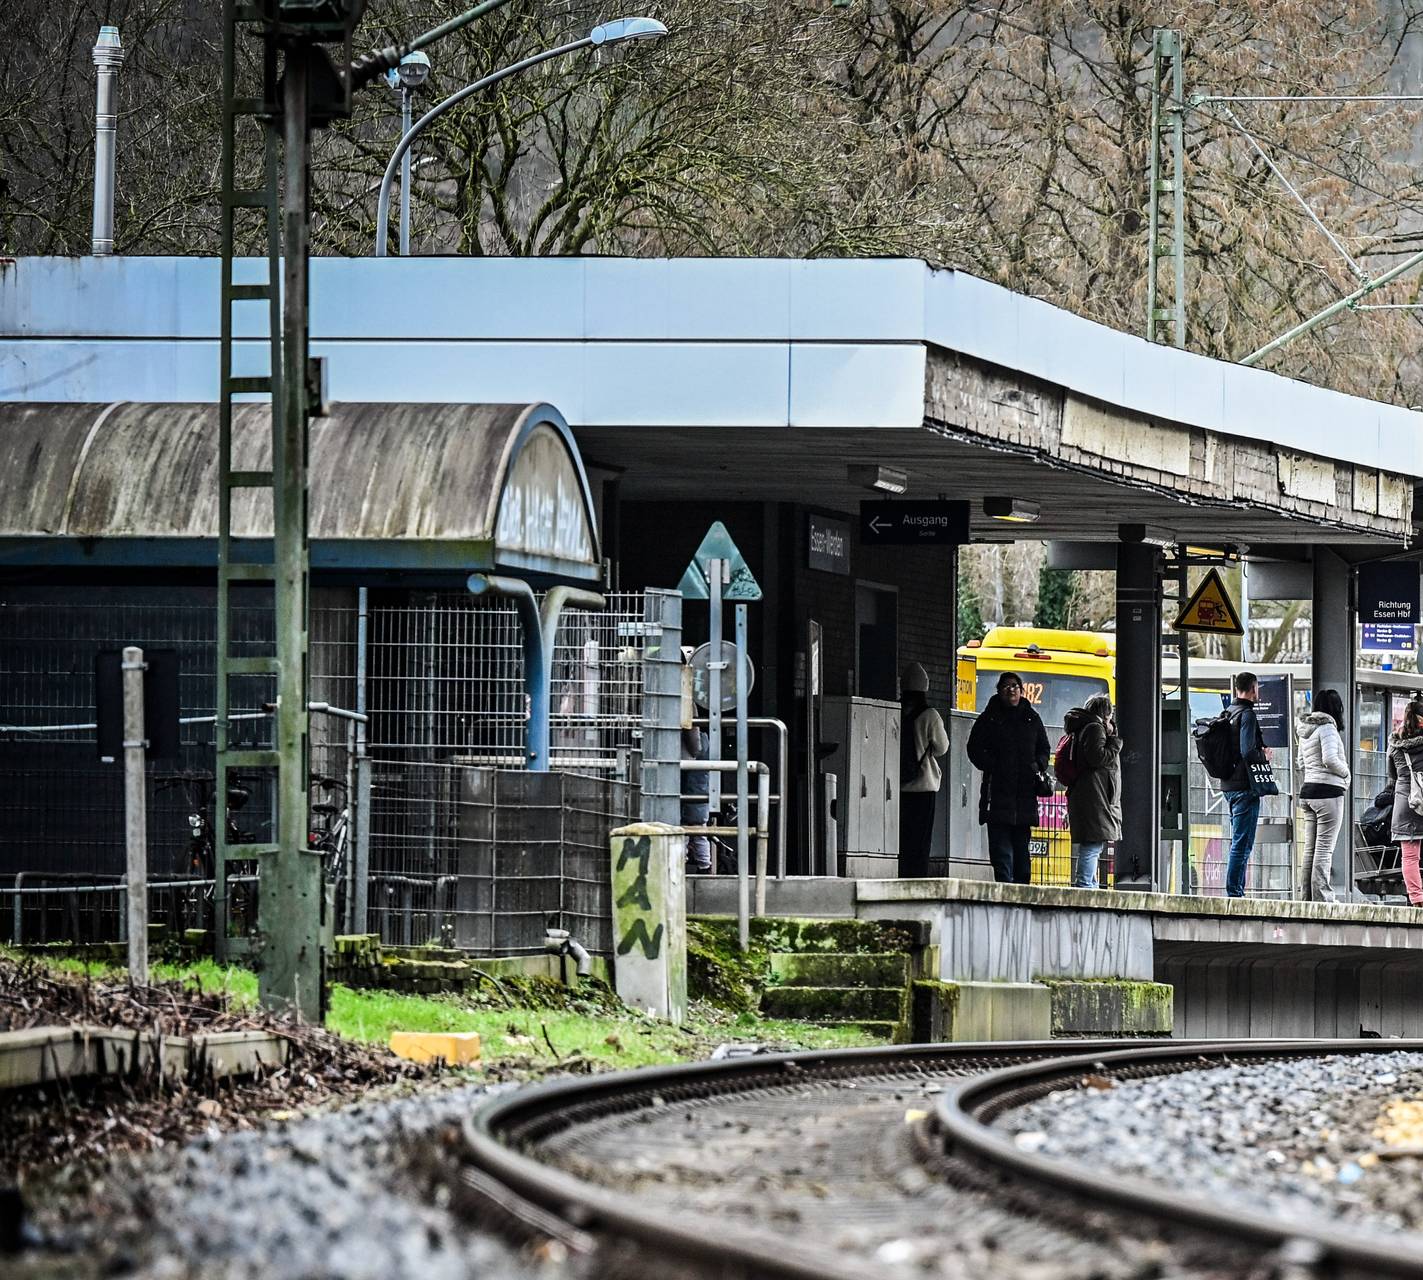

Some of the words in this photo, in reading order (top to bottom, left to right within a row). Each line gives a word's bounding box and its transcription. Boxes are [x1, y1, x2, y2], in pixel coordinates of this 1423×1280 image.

[902, 514, 948, 527] Ausgang
[811, 524, 844, 558] Essen-Werden
[1378, 600, 1411, 610] Richtung
[1373, 610, 1396, 618] Essen
[1397, 610, 1411, 618] Hbf
